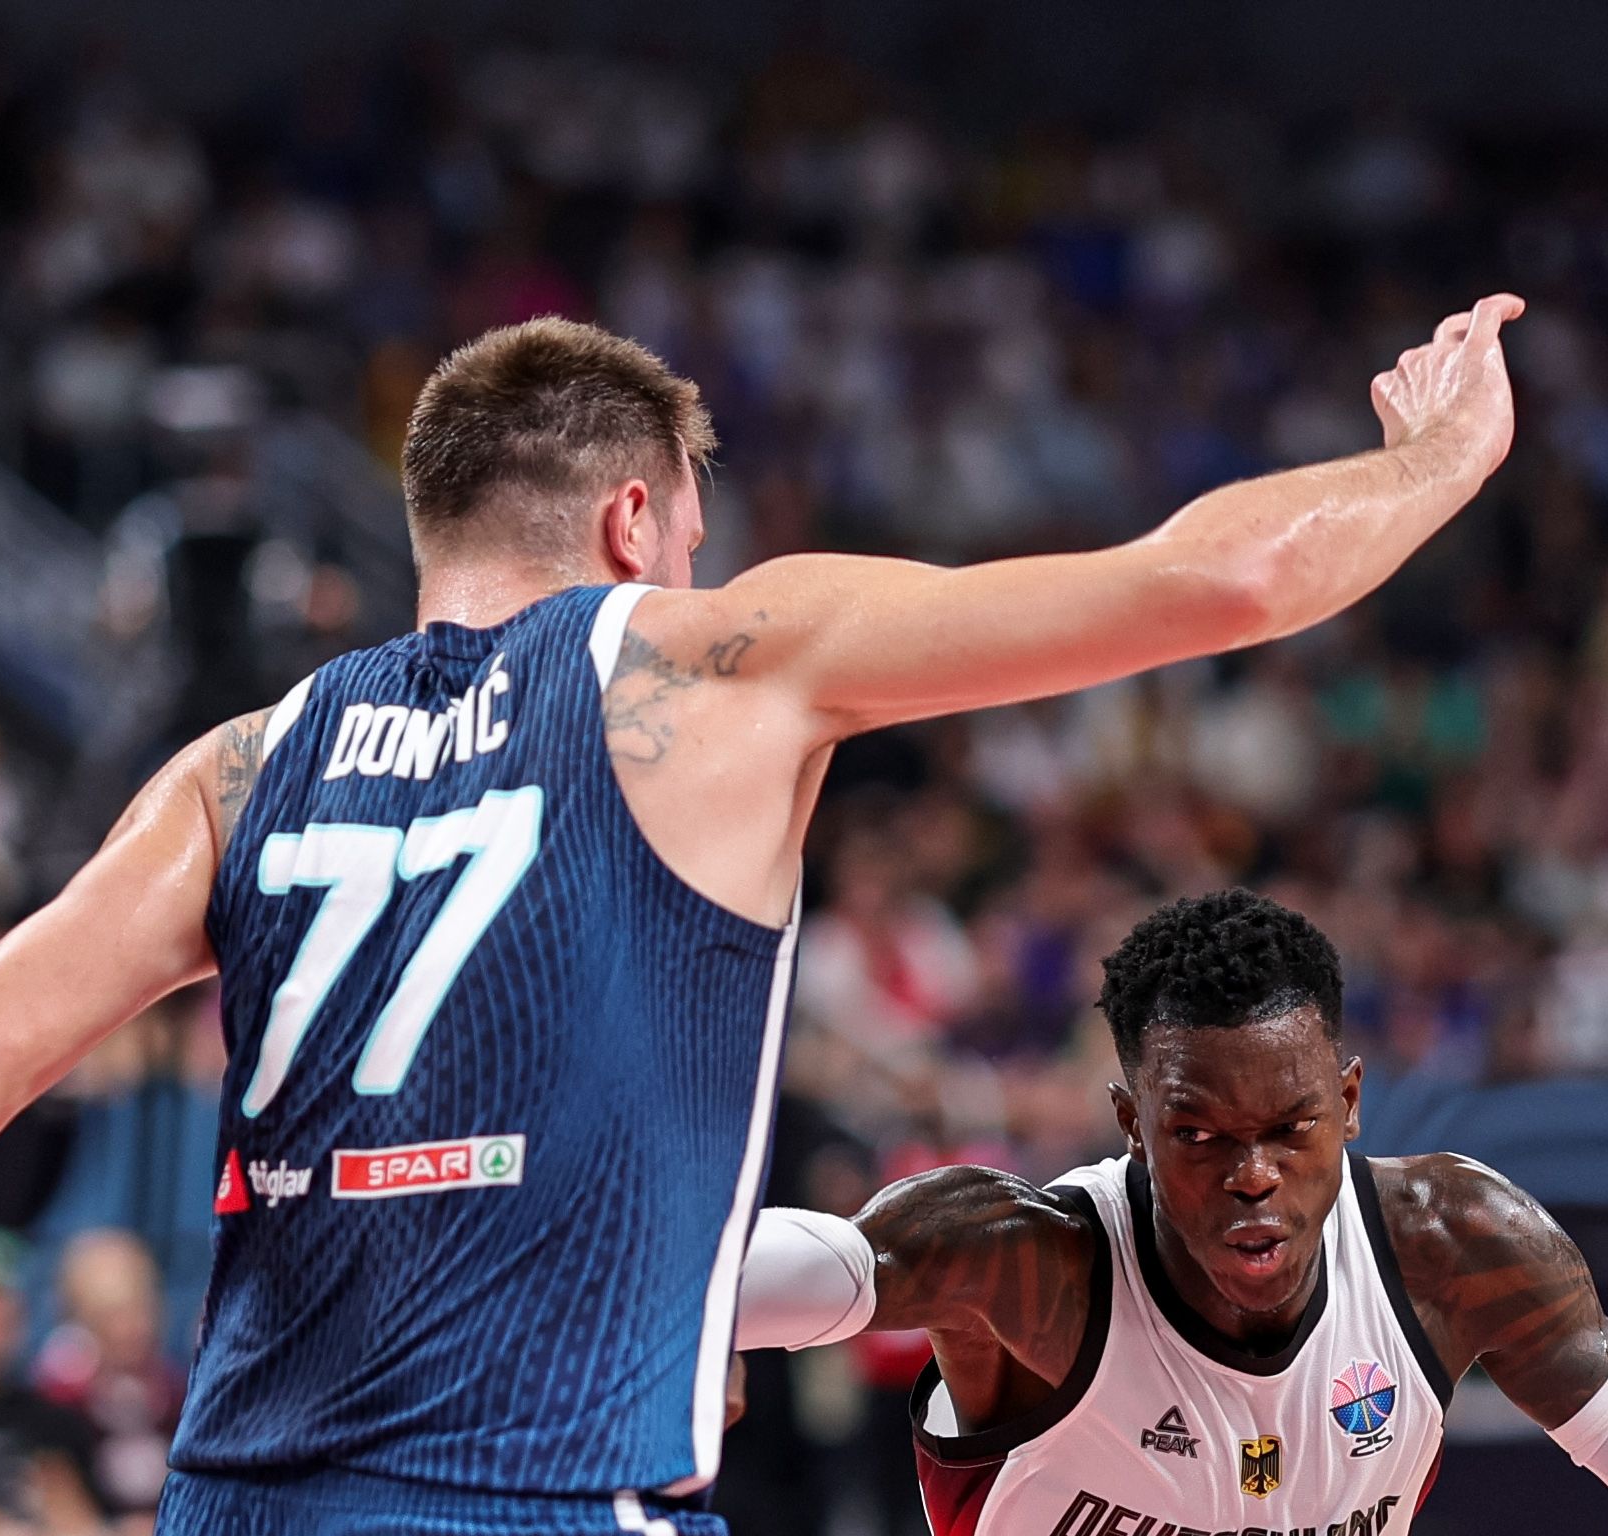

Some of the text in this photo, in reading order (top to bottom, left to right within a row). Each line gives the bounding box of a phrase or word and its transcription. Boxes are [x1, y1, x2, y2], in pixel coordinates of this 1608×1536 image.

[323, 652, 509, 781] DONIĆ
[242, 785, 544, 1118] 77
[367, 1151, 468, 1186] SPAR
[1141, 1428, 1200, 1458] PEAK
[1349, 1427, 1393, 1457] 25
